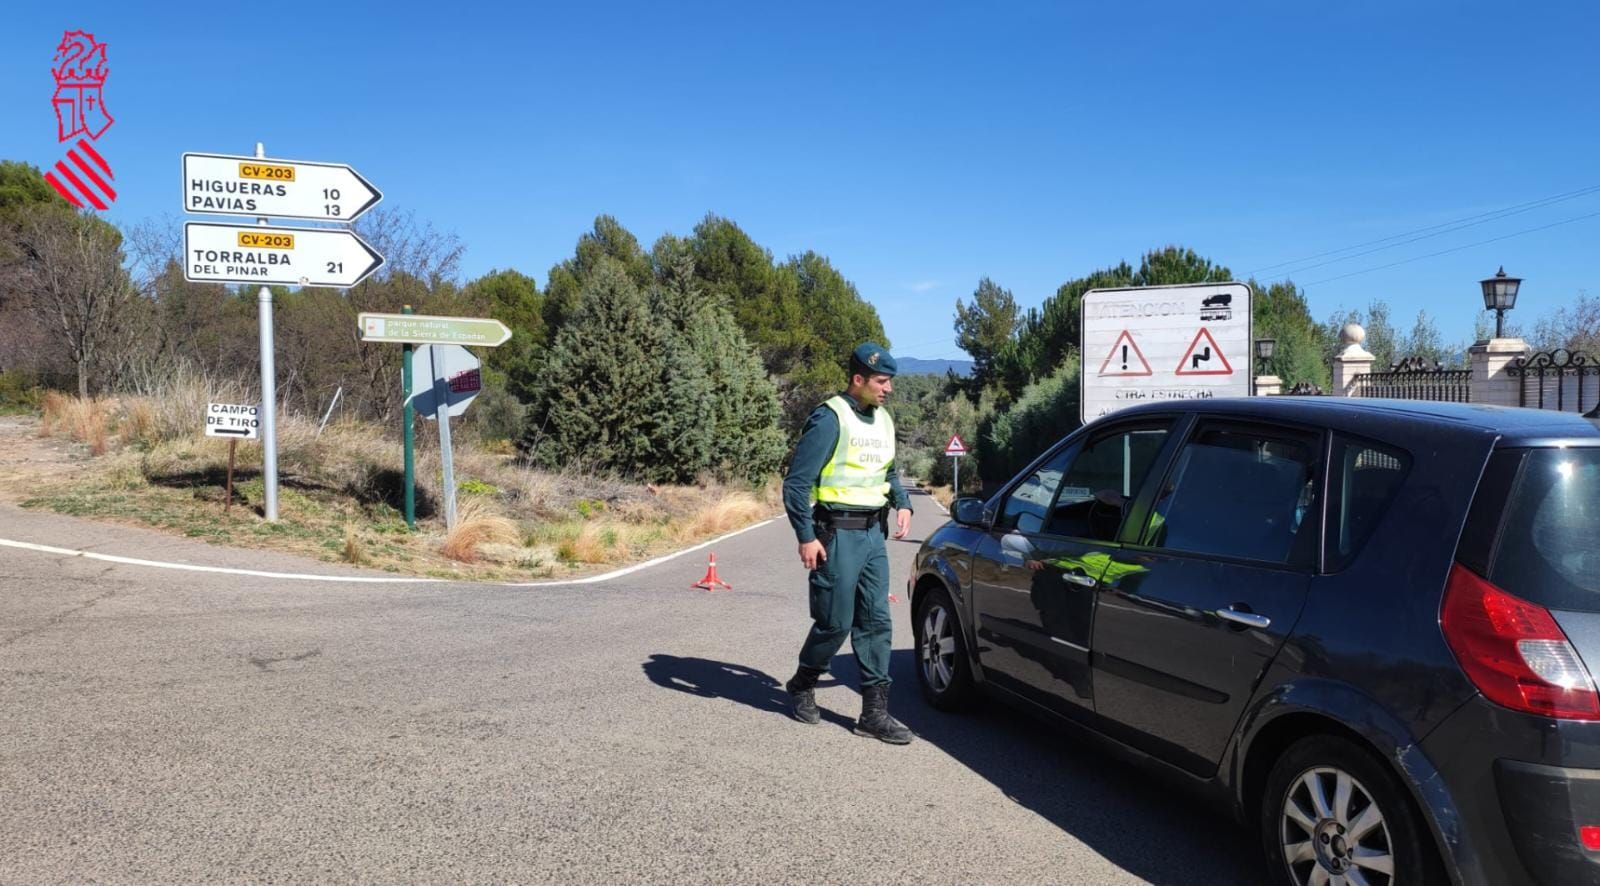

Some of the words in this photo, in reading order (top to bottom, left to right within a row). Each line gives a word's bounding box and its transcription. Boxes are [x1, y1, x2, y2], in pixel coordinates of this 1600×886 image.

[242, 165, 292, 179] CV-203
[191, 179, 286, 197] HIGUERAS
[323, 188, 340, 200] 10
[192, 195, 257, 210] PAVIAS
[324, 204, 341, 216] 13
[240, 234, 291, 247] CV-203
[193, 249, 291, 266] TORRALBA
[326, 261, 342, 274] 21
[193, 264, 219, 274] DEL
[226, 266, 268, 276] PINAR
[388, 319, 417, 329] parque
[419, 321, 449, 329] natural
[388, 329, 400, 337] de
[401, 329, 410, 337] la
[412, 330, 437, 338] Sierra
[439, 331, 449, 339] de
[1151, 388, 1213, 399] ESTRECHA
[211, 404, 257, 415] CAMPO
[207, 416, 223, 425] DE
[228, 417, 259, 427] TIRO
[850, 437, 888, 448] GUARDIA
[859, 453, 882, 463] CIVIL
